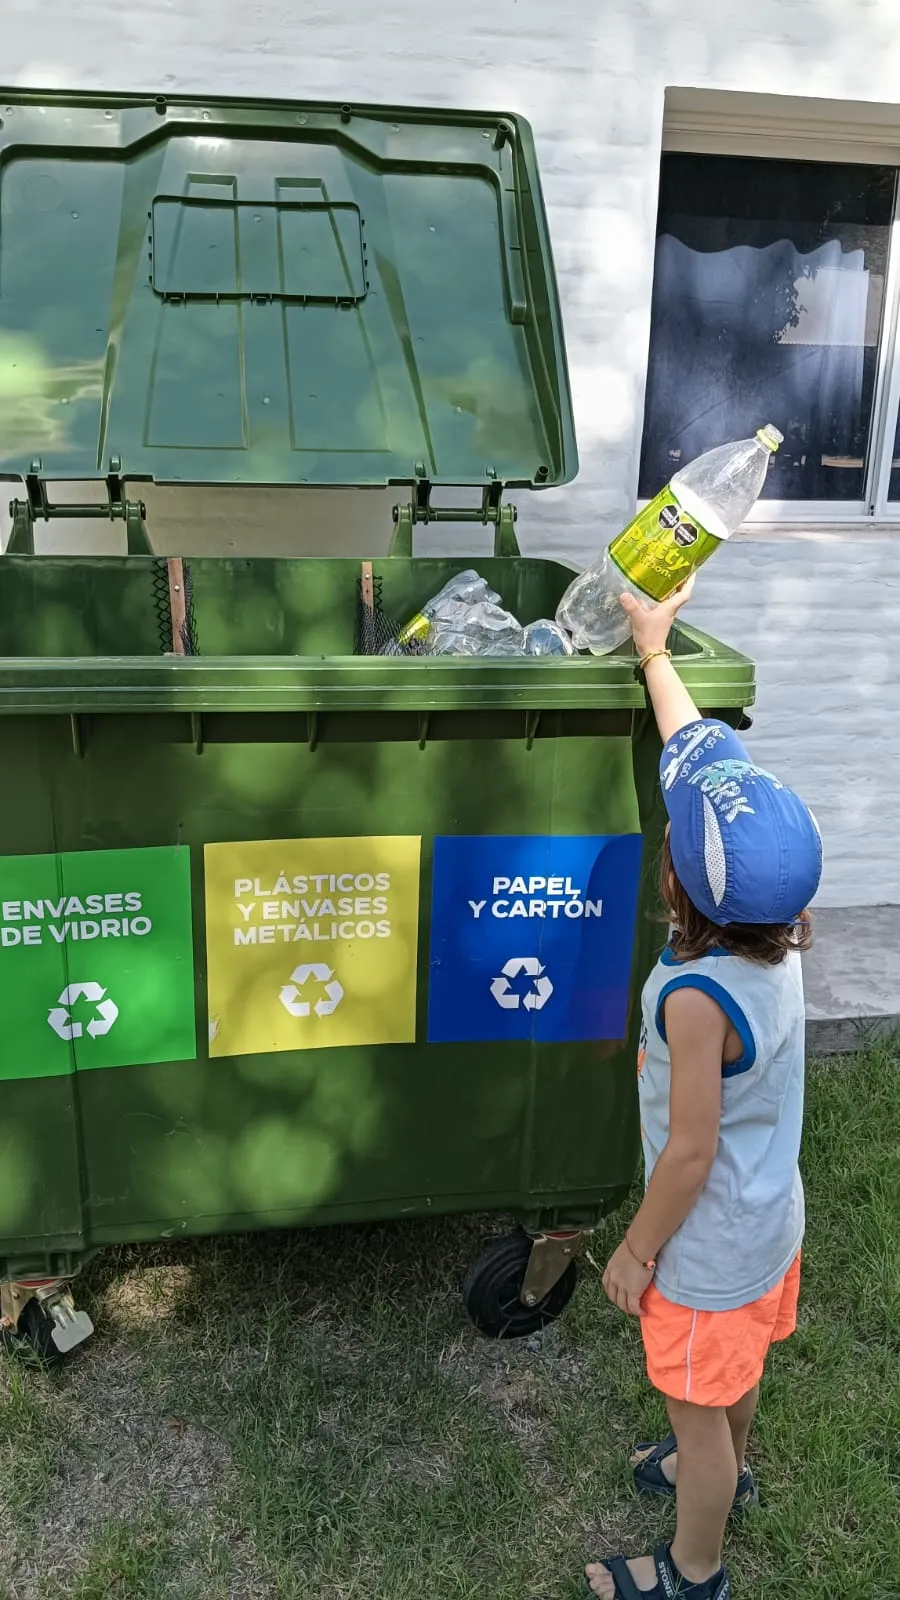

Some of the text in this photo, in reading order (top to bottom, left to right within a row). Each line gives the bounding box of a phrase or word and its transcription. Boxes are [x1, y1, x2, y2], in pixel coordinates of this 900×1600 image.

[234, 870, 391, 898] PLÁSTICOS
[492, 876, 581, 895] PAPEL
[2, 892, 142, 921] ENVASES
[237, 897, 388, 921] Y ENVASES
[468, 894, 603, 918] Y CARTÓN
[1, 916, 152, 947] DE VIDRIO
[233, 917, 392, 946] METÁLICOS
[658, 1561, 674, 1598] STONE
